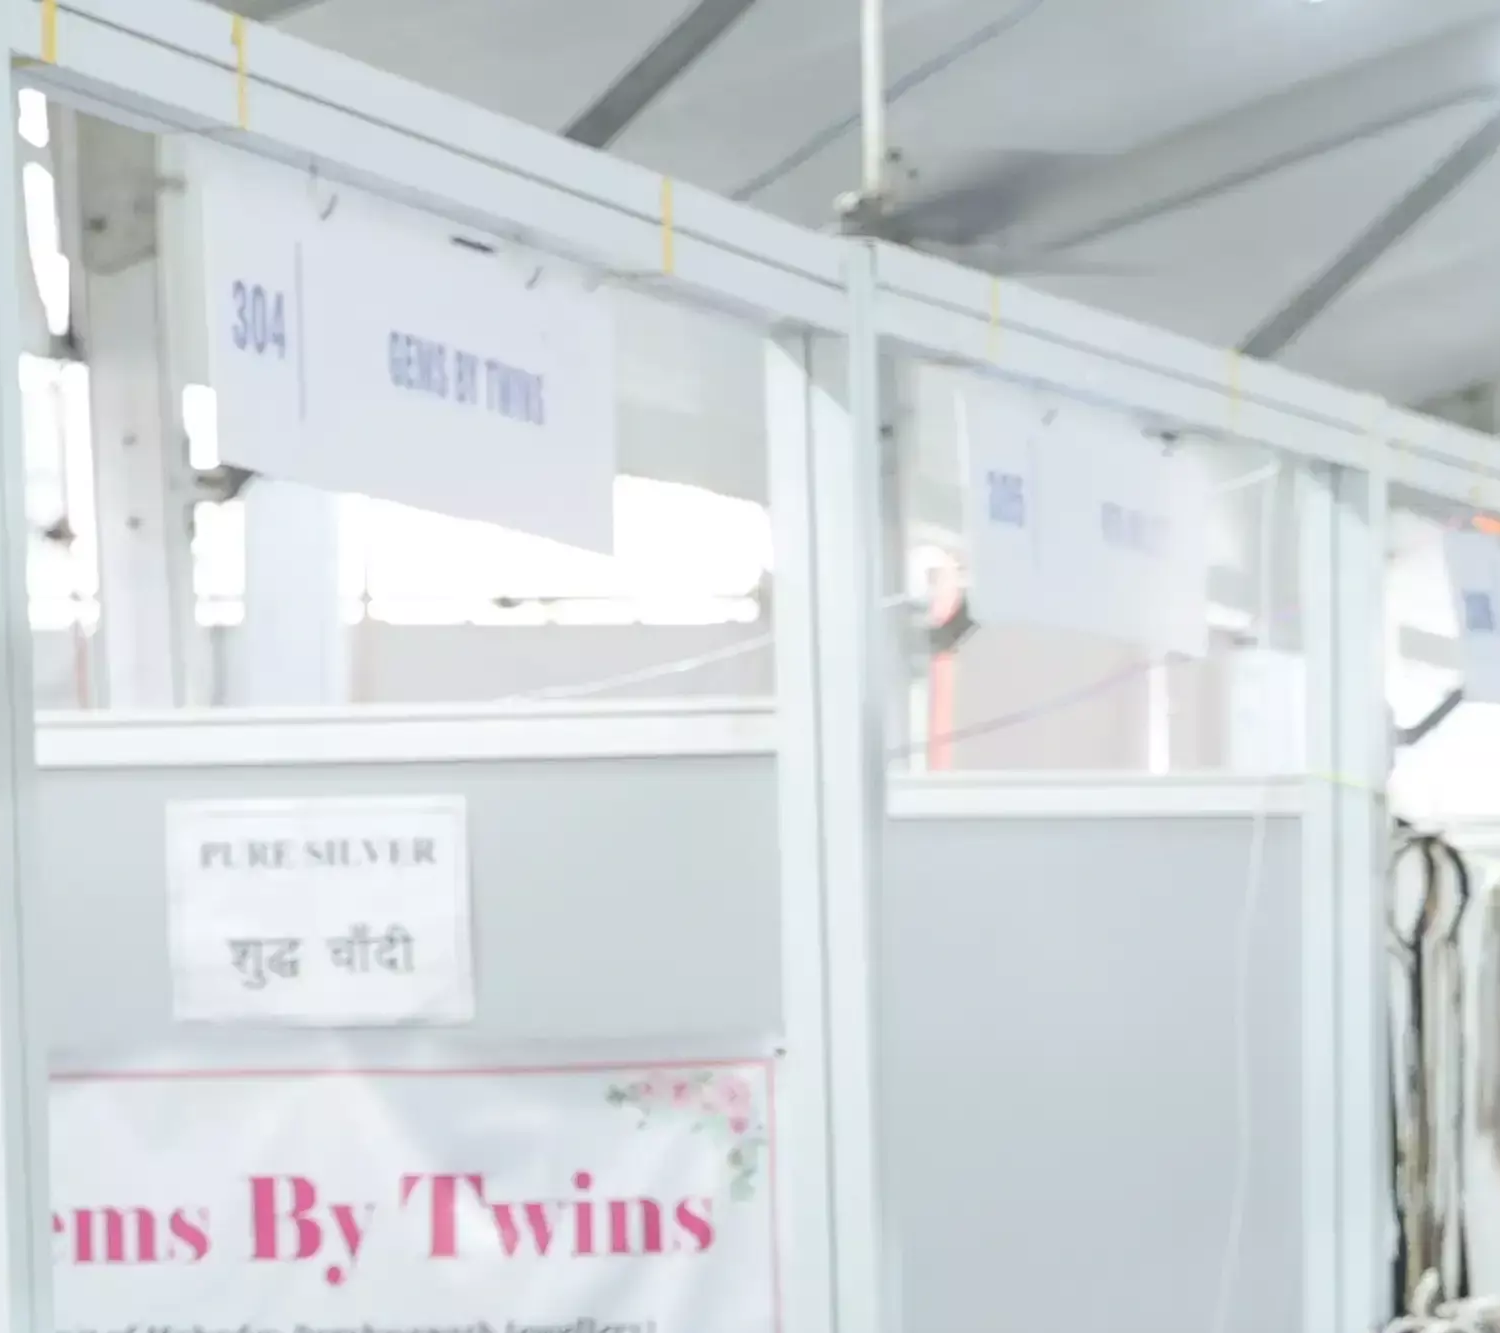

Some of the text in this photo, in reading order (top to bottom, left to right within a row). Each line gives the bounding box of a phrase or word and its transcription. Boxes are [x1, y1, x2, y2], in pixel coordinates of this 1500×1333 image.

[232, 279, 285, 358] 304
[200, 837, 437, 869] PURE SILVER
[53, 1170, 715, 1286] ms By Twins
